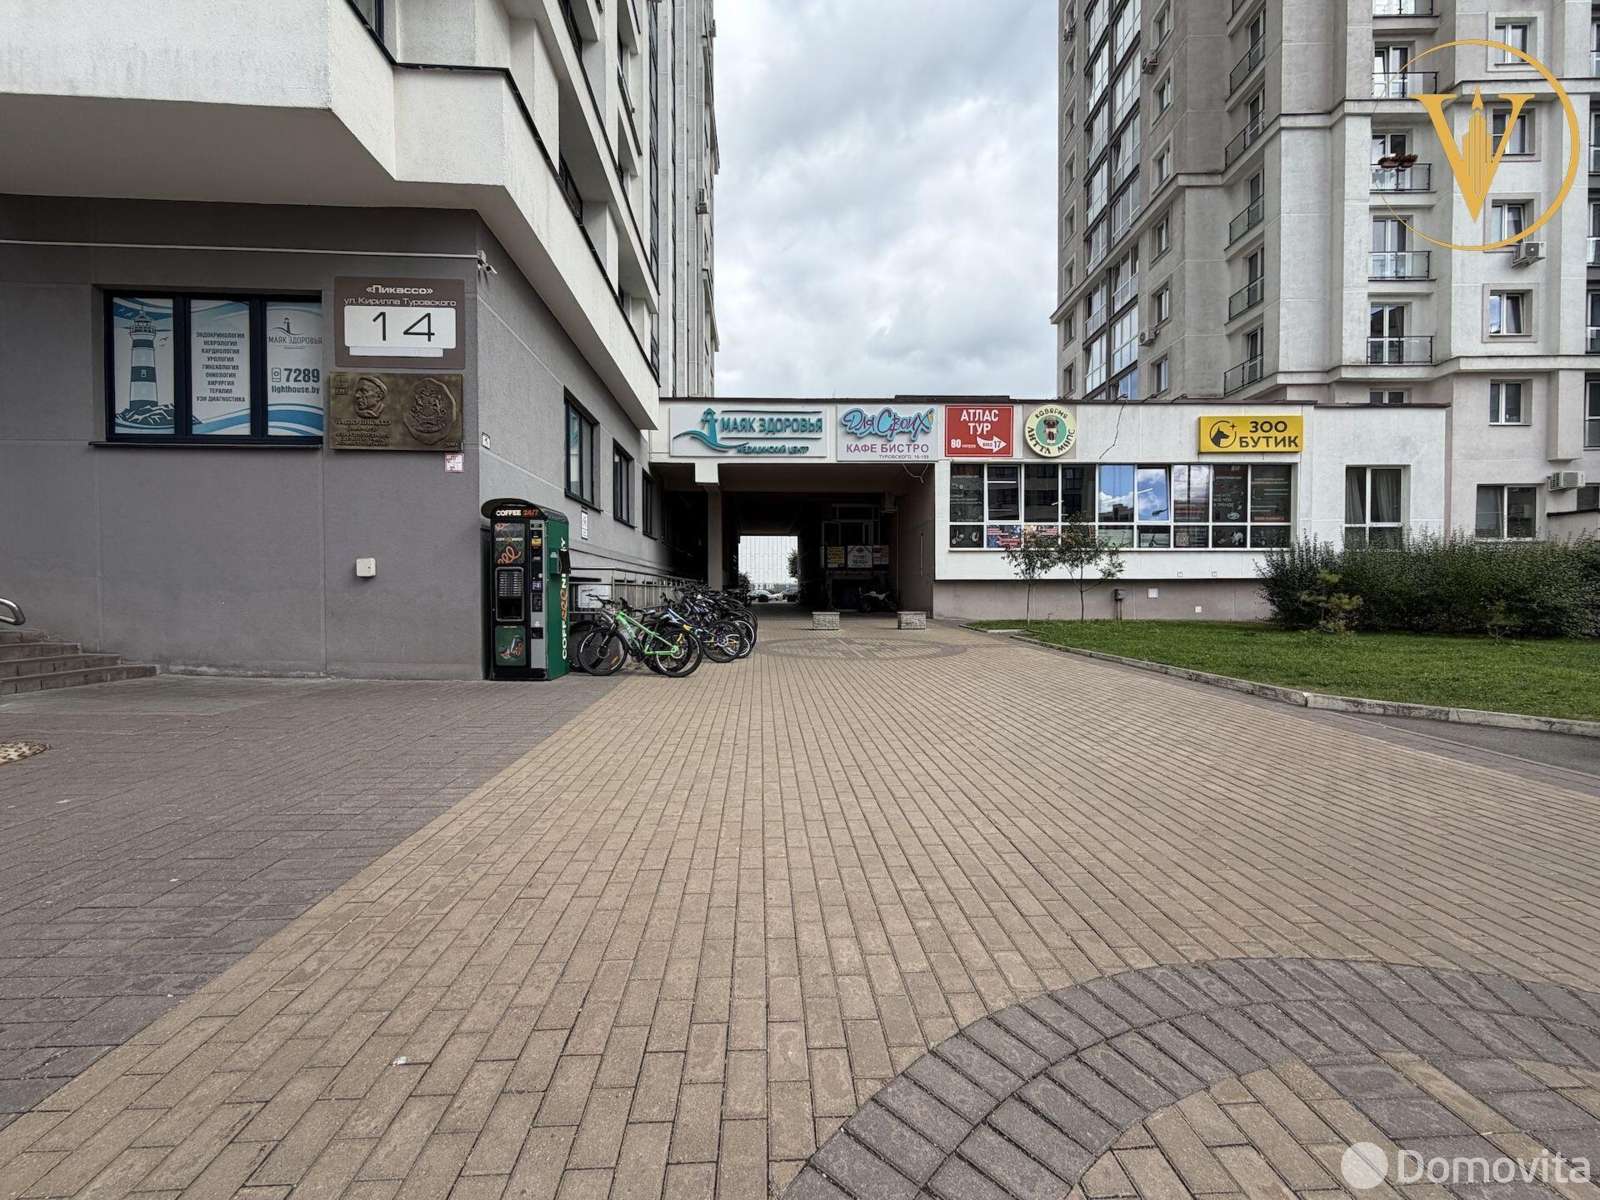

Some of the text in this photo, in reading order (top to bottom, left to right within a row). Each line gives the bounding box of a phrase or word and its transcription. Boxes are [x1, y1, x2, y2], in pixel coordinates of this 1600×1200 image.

[366, 284, 434, 294] «Пикассо»
[358, 297, 401, 305] Кирилла
[402, 298, 457, 307] Туровского
[372, 311, 435, 342] 14
[268, 336, 323, 345] МАЯК ЗДОРОВЬЯ
[283, 368, 320, 383] 7289
[271, 385, 320, 395] lighthouse.by
[960, 409, 999, 422] АТЛАС
[720, 417, 823, 435] МАЯК ЗДОРОВЬЯ
[968, 422, 992, 435] ТУР
[1249, 421, 1288, 433] ЗОО
[950, 438, 962, 449] 80
[993, 440, 1001, 449] 17
[1057, 428, 1076, 453] МОПС
[1239, 436, 1299, 448] БУТИК
[846, 444, 929, 453] КАФЕ БИСТРО
[495, 509, 522, 517] COFFEE
